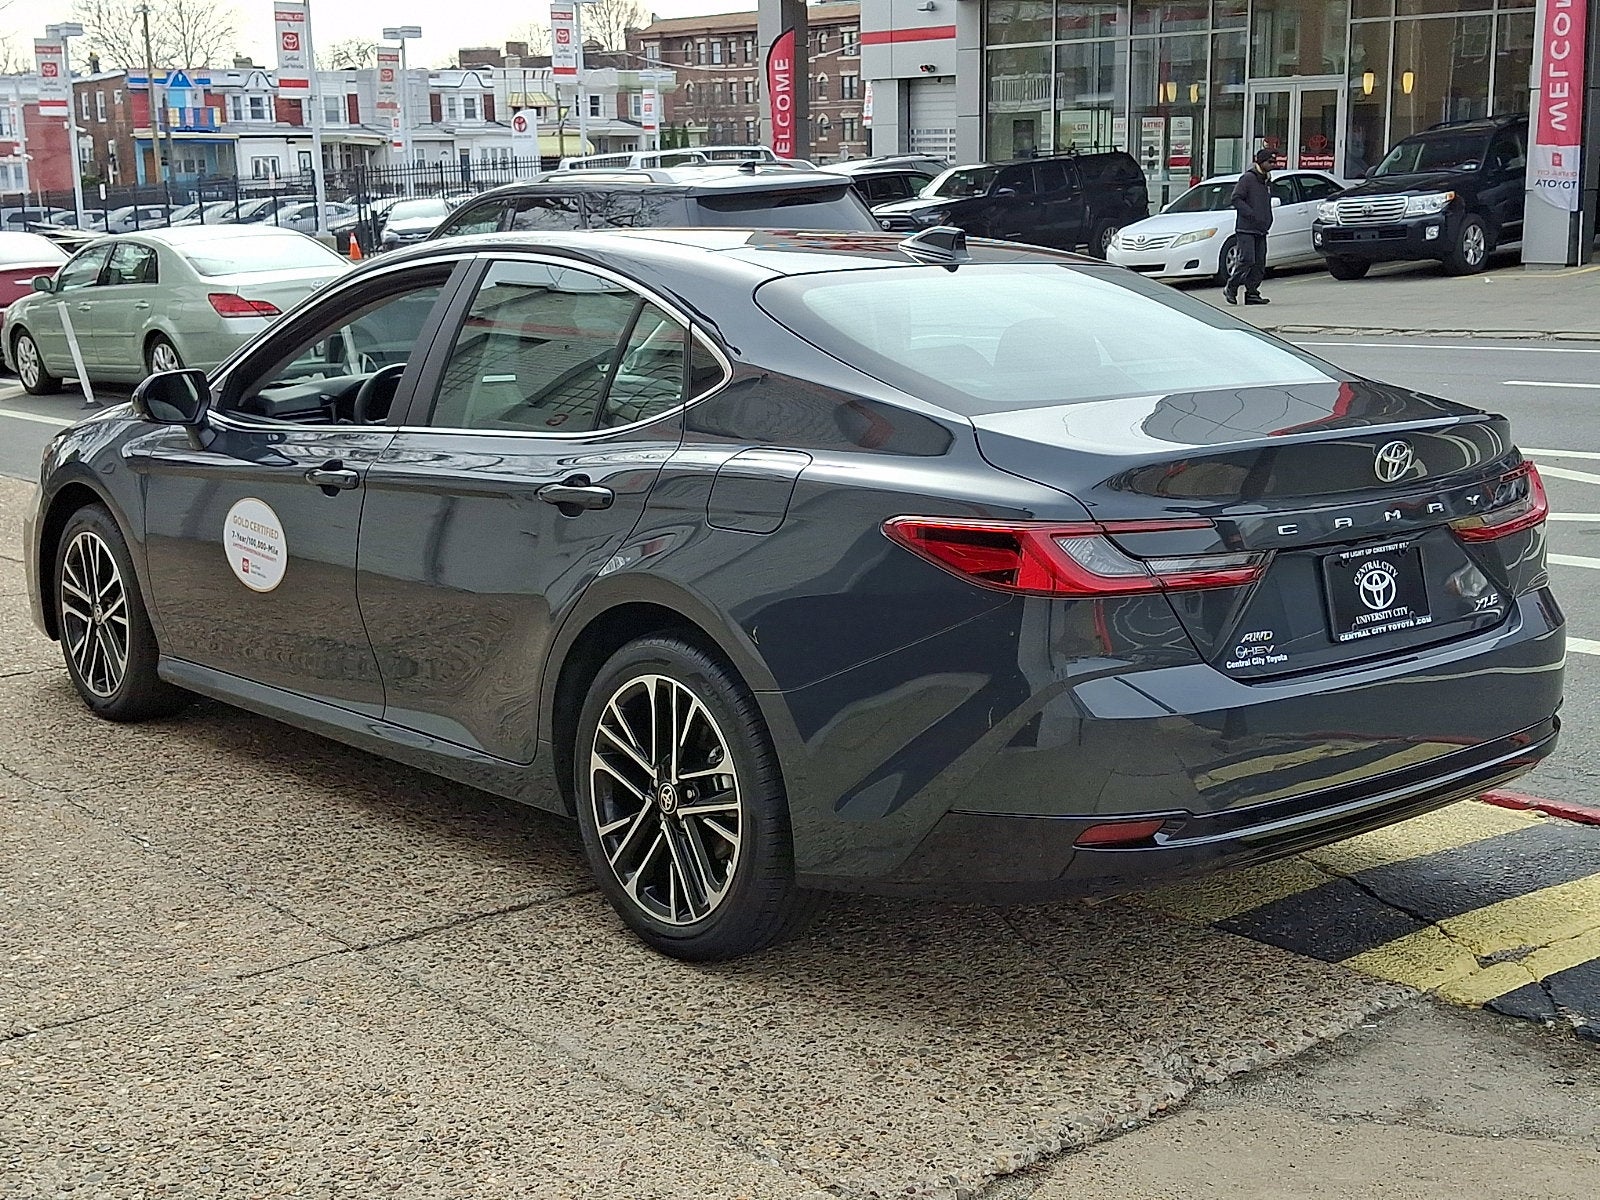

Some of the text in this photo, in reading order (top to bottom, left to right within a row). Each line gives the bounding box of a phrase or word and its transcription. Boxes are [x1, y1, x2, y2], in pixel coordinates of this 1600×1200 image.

[775, 58, 790, 153] ELCOME
[1277, 494, 1480, 536] CAMRY
[233, 515, 279, 540] GOLD CERTIFIED
[1353, 560, 1399, 586] CENTRAL CITY
[1355, 605, 1409, 625] UNIVERSITY CITY
[1240, 630, 1274, 643] AWD
[1340, 629, 1371, 642] CENTRAL
[1371, 626, 1387, 635] CITY
[1388, 620, 1415, 631] TOYOTA
[1226, 654, 1288, 669] Central City Toyota
